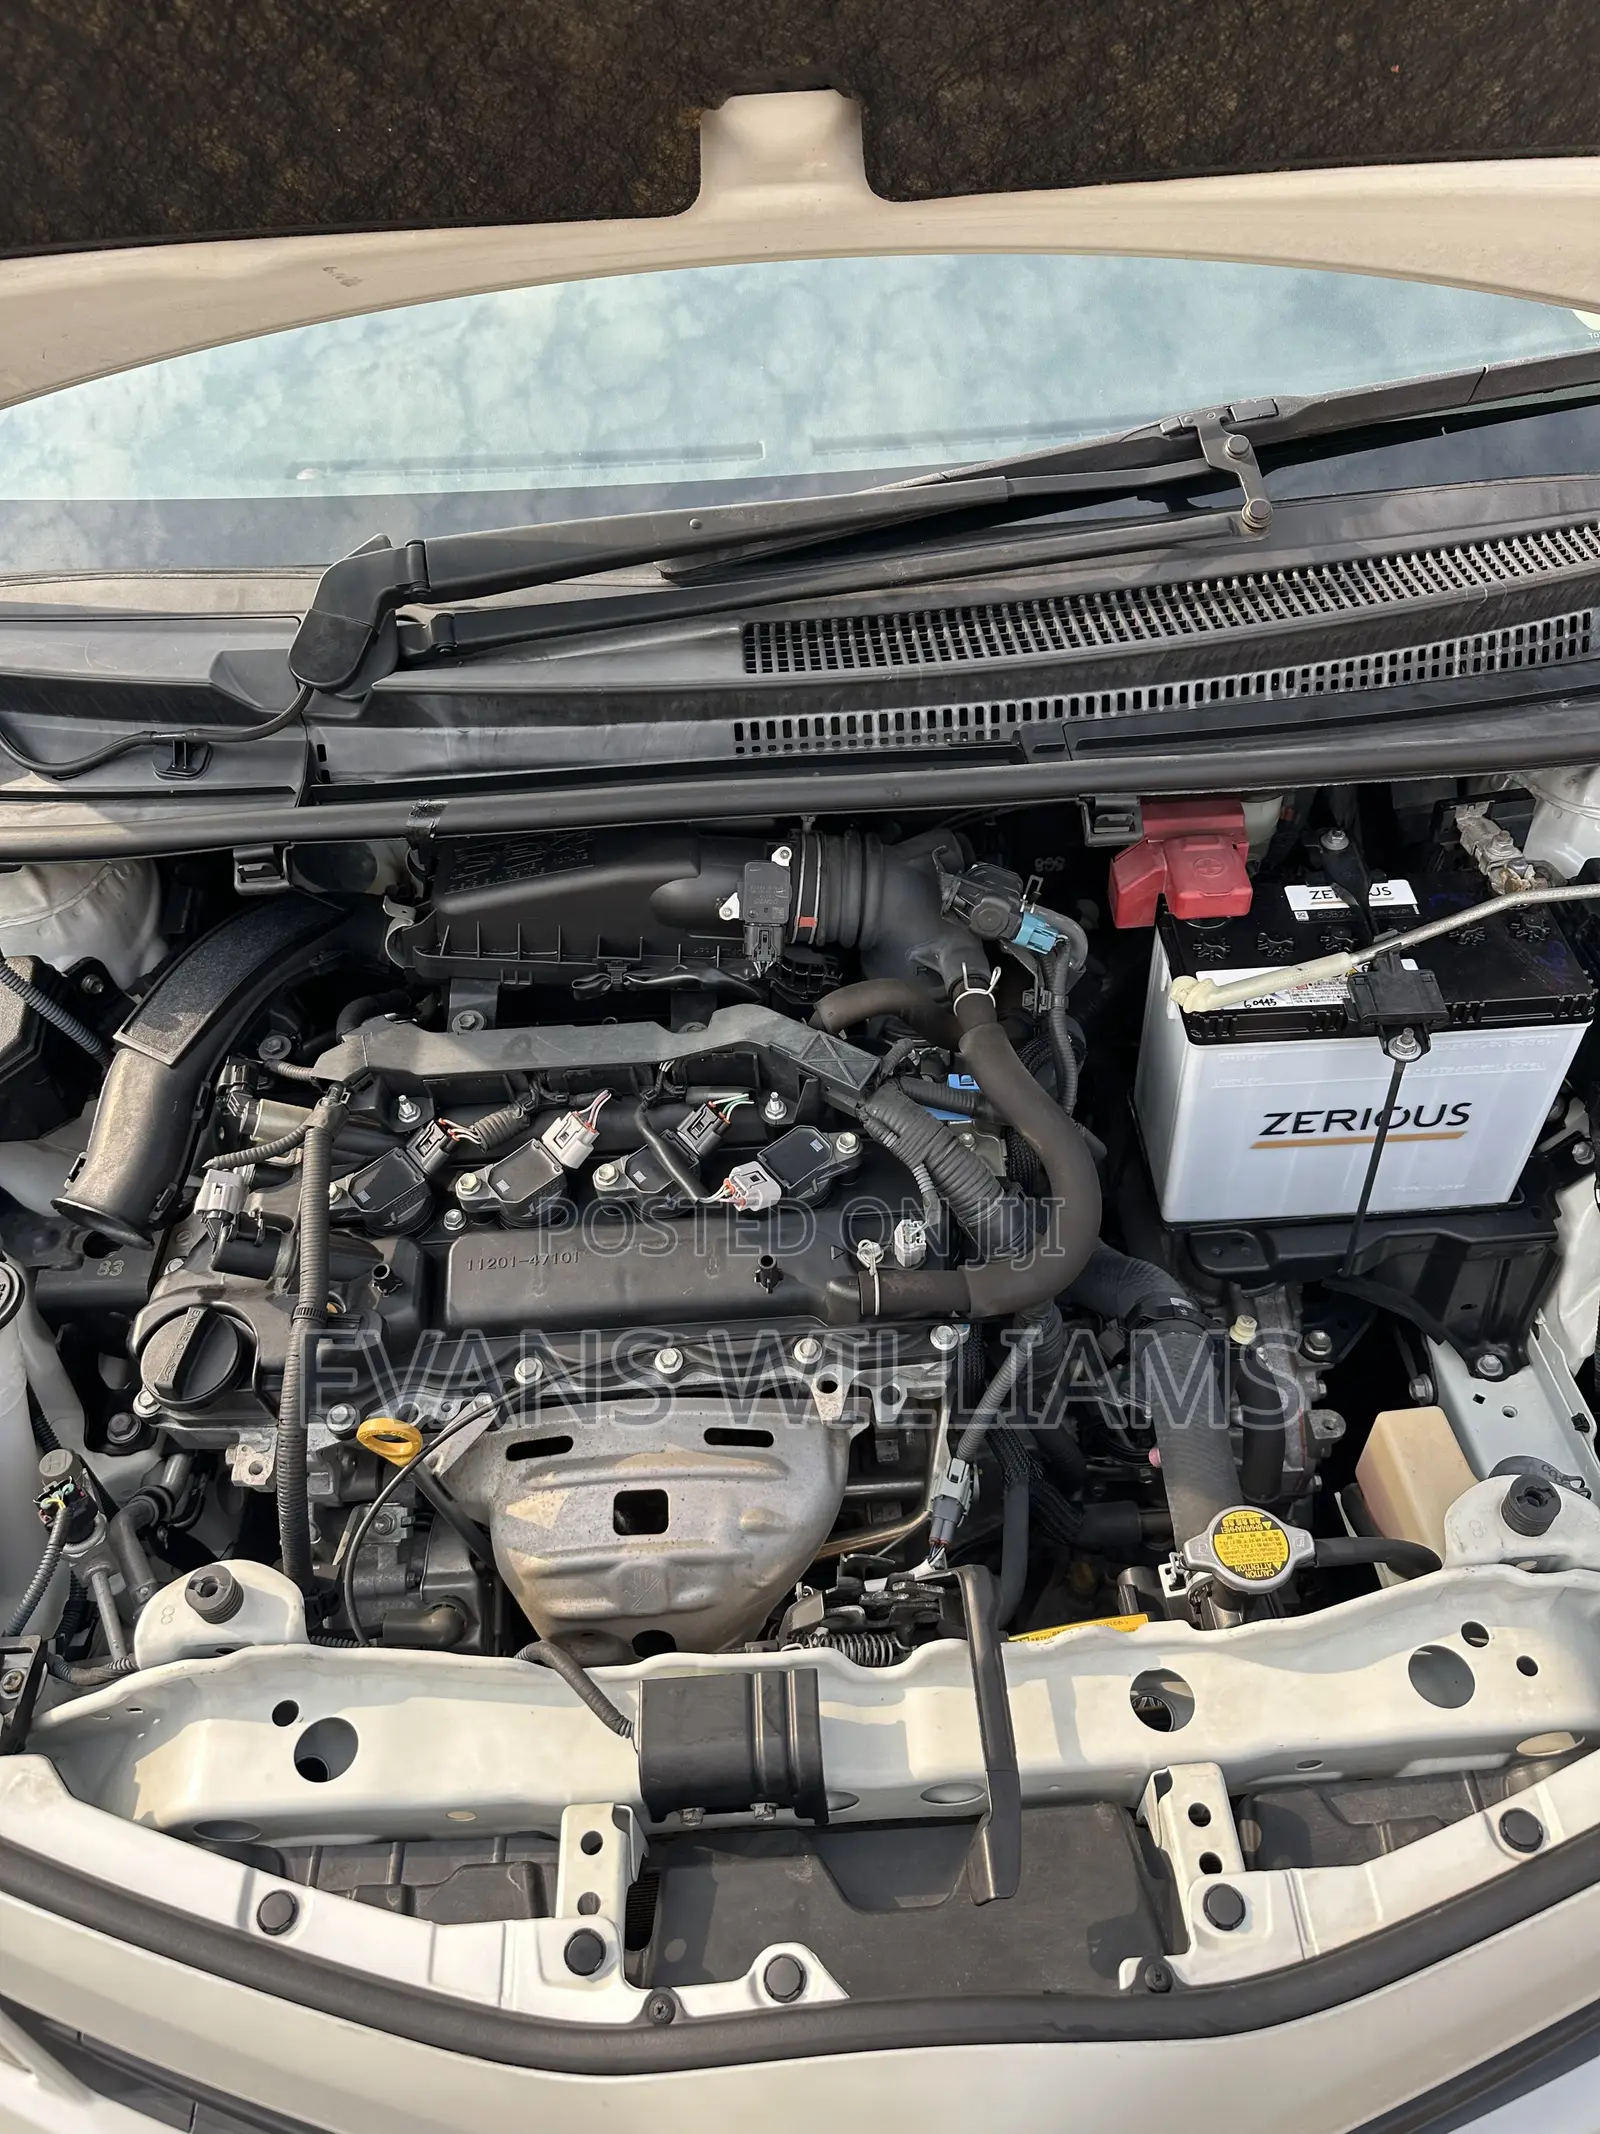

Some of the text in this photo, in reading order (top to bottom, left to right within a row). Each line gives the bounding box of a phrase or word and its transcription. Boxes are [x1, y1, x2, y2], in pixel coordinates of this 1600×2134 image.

[1258, 1102, 1473, 1136] ZERIOUS
[96, 1259, 124, 1276] 83
[466, 1251, 580, 1271] 11201-47101
[1234, 1562, 1272, 1572] ATTENTION
[1245, 1569, 1275, 1578] CAUTION
